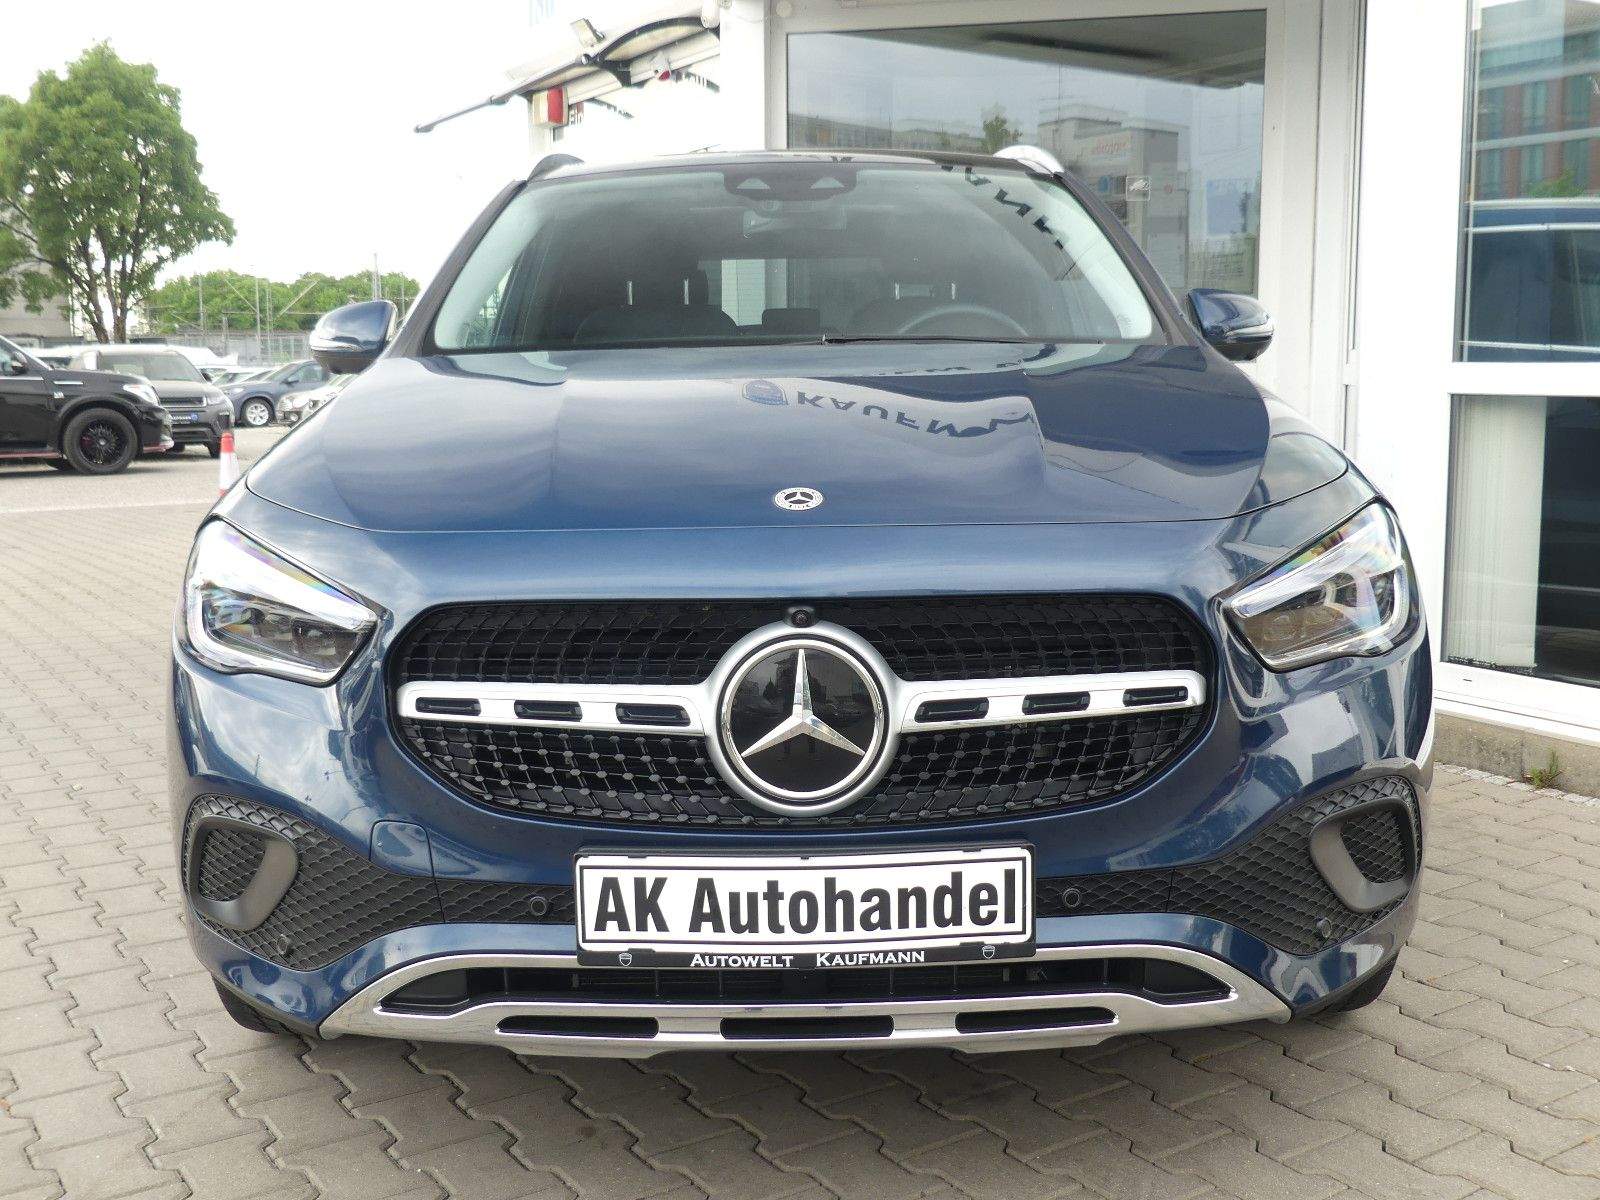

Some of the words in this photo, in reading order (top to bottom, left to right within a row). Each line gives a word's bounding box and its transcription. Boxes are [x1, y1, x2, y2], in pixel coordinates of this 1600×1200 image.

[594, 877, 670, 932] AK
[689, 869, 1016, 934] Autohandel
[690, 953, 793, 968] AUTOWELT
[816, 950, 925, 967] KAUFMANN
